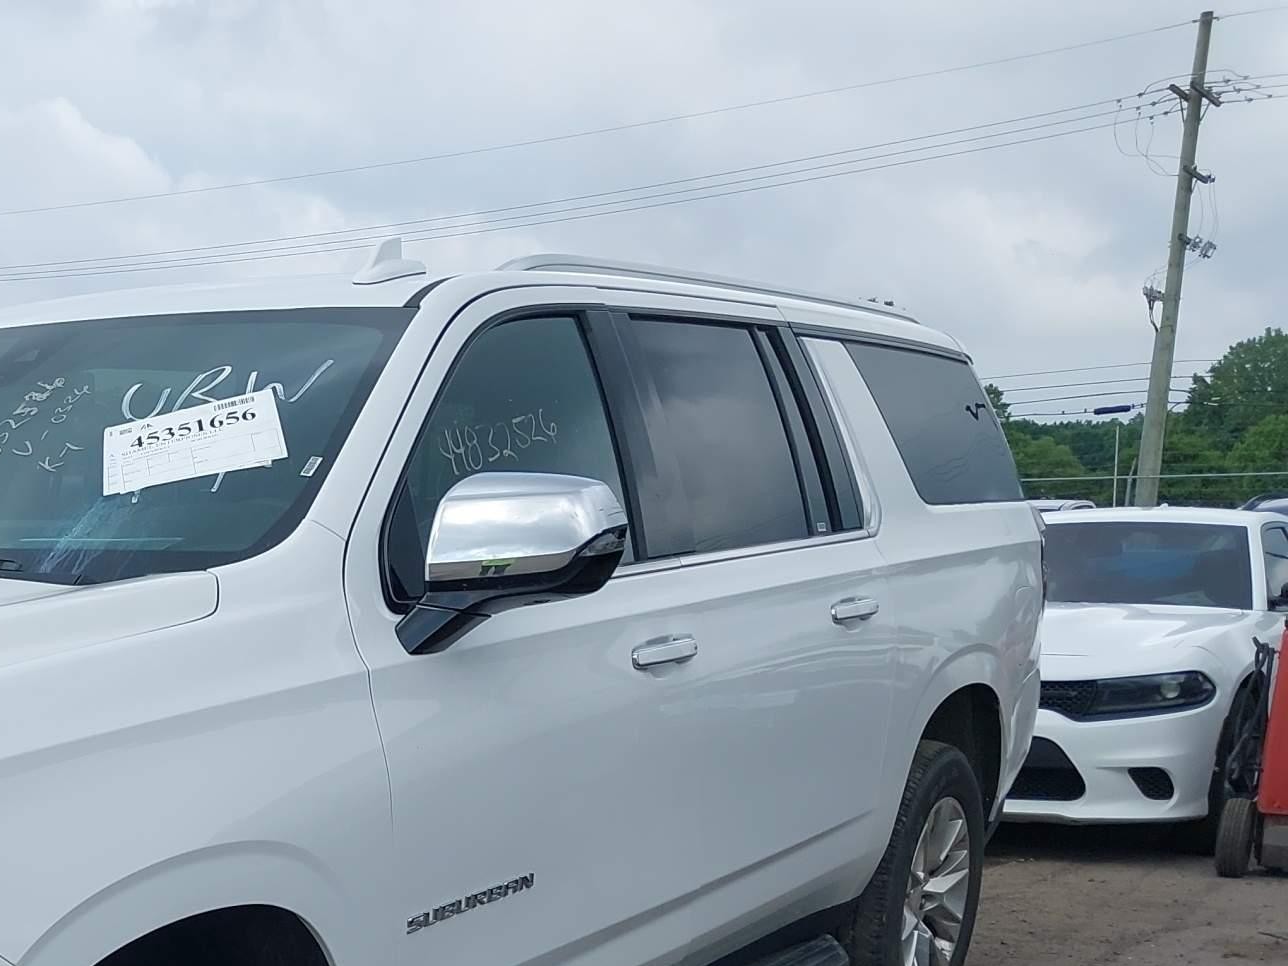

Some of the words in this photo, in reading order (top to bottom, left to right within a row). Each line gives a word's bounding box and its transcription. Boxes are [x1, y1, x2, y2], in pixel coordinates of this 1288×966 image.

[130, 407, 258, 449] 45351656
[439, 408, 558, 475] 44832526
[406, 872, 535, 935] SUBURBAN
